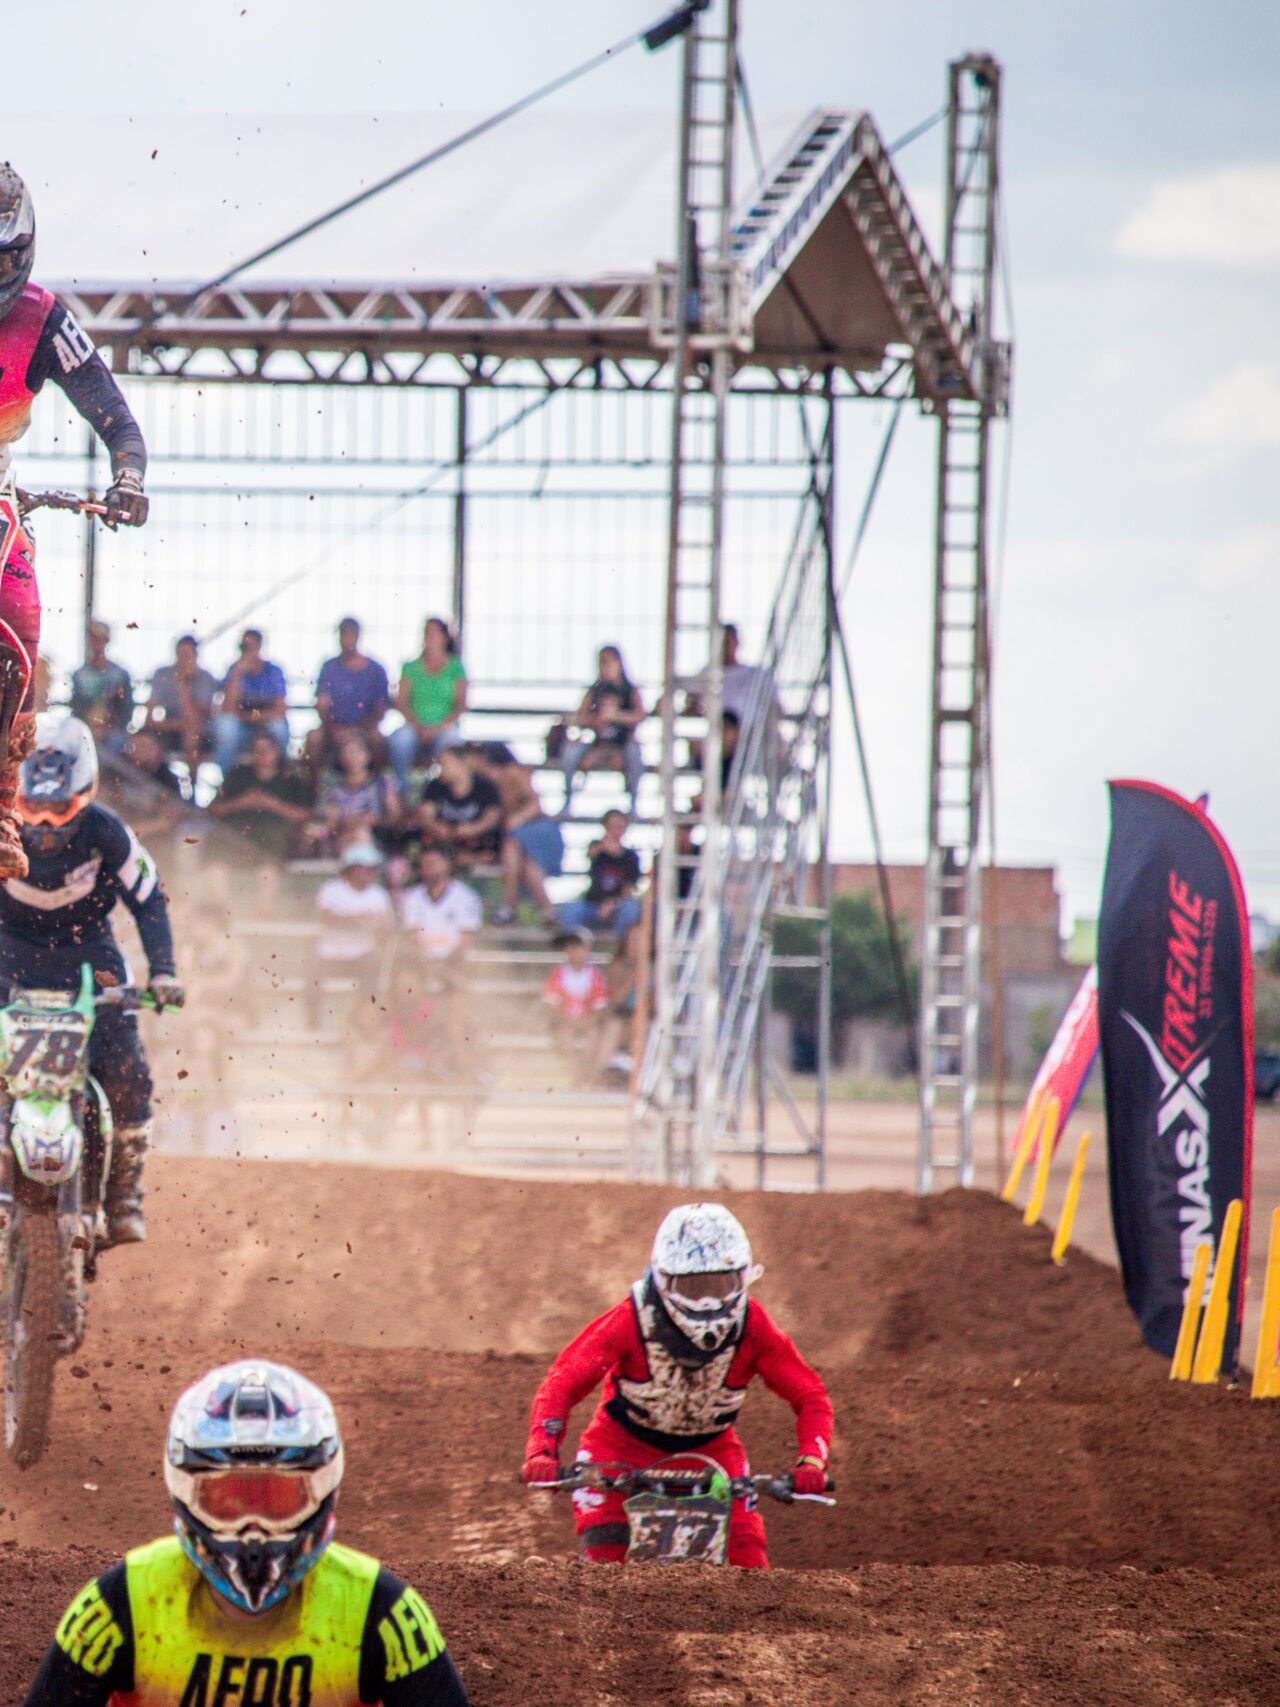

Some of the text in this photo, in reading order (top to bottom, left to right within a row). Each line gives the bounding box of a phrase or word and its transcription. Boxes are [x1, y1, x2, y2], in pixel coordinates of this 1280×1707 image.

[52, 308, 96, 374] AE
[5, 1028, 84, 1076] 78
[55, 1578, 124, 1677] ERO
